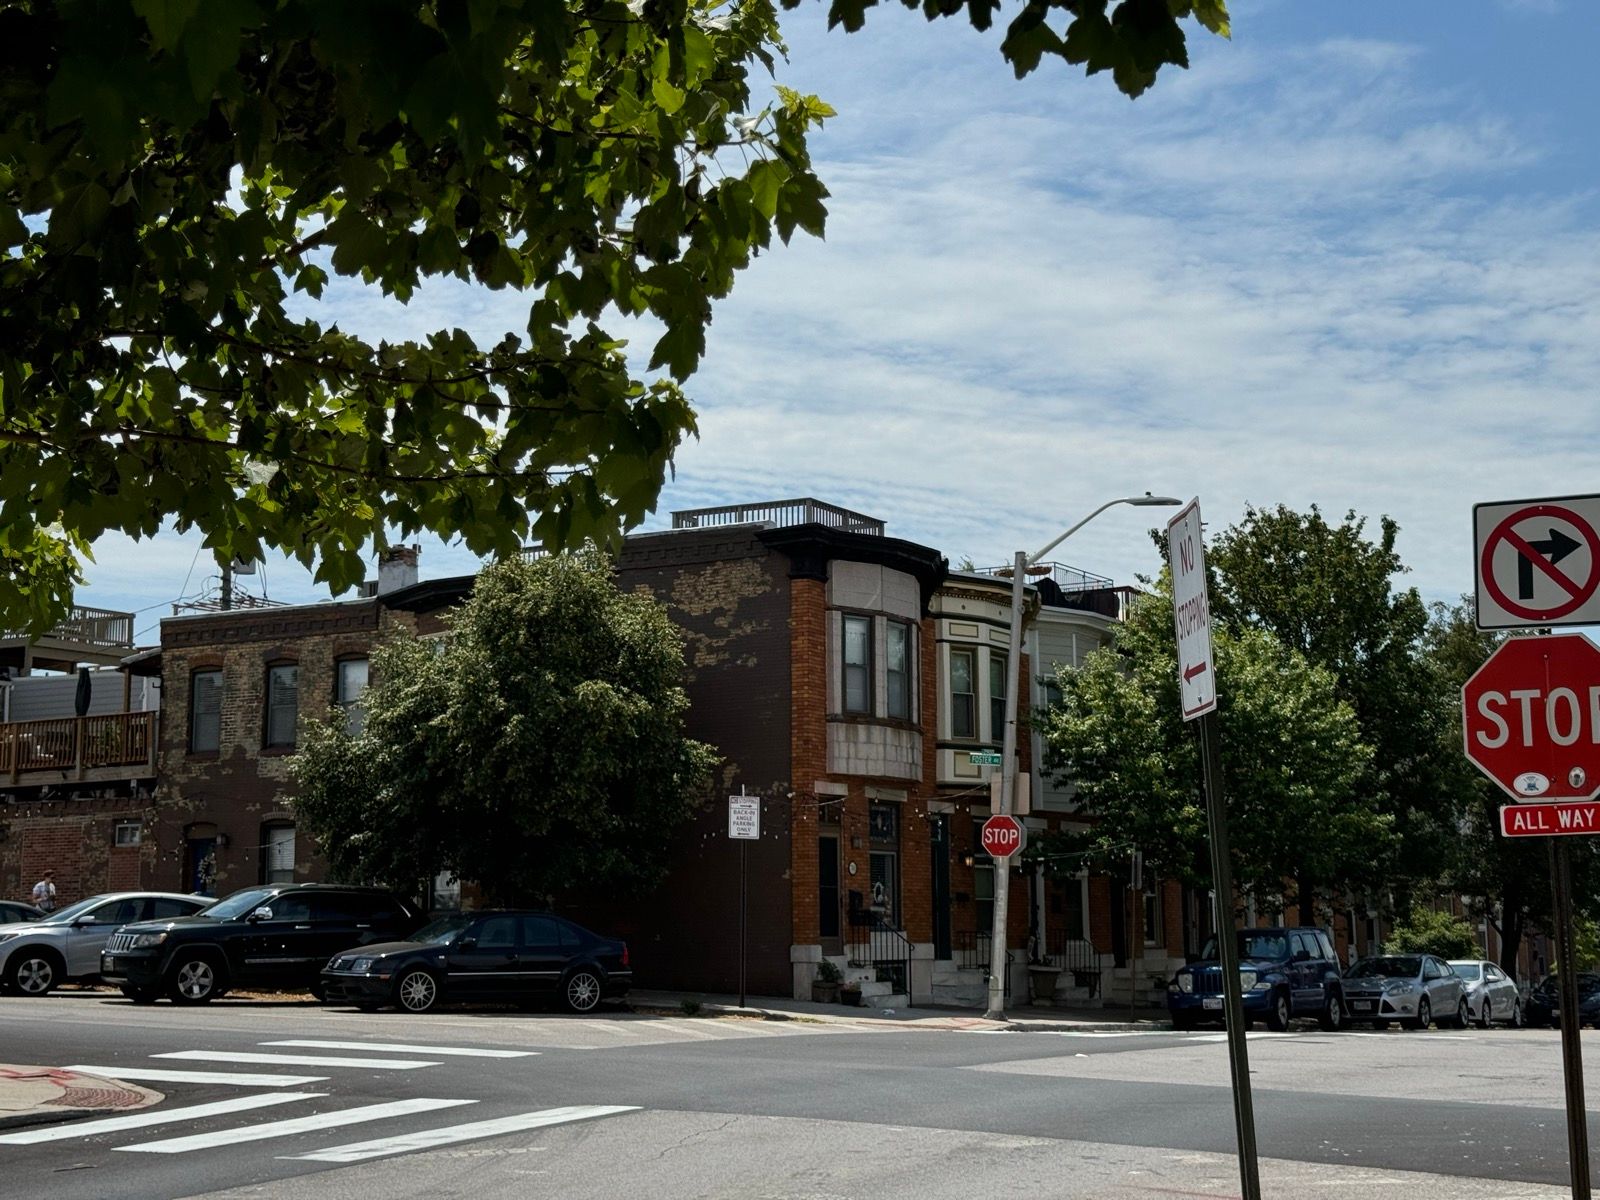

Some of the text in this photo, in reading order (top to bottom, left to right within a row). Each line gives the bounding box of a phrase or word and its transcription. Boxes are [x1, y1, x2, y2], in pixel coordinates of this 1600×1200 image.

[1179, 534, 1194, 576] NO
[1177, 591, 1206, 640] STOPPING
[971, 755, 992, 764] FOSTER
[1513, 807, 1596, 831] ALL WAY
[984, 828, 1018, 845] STOP
